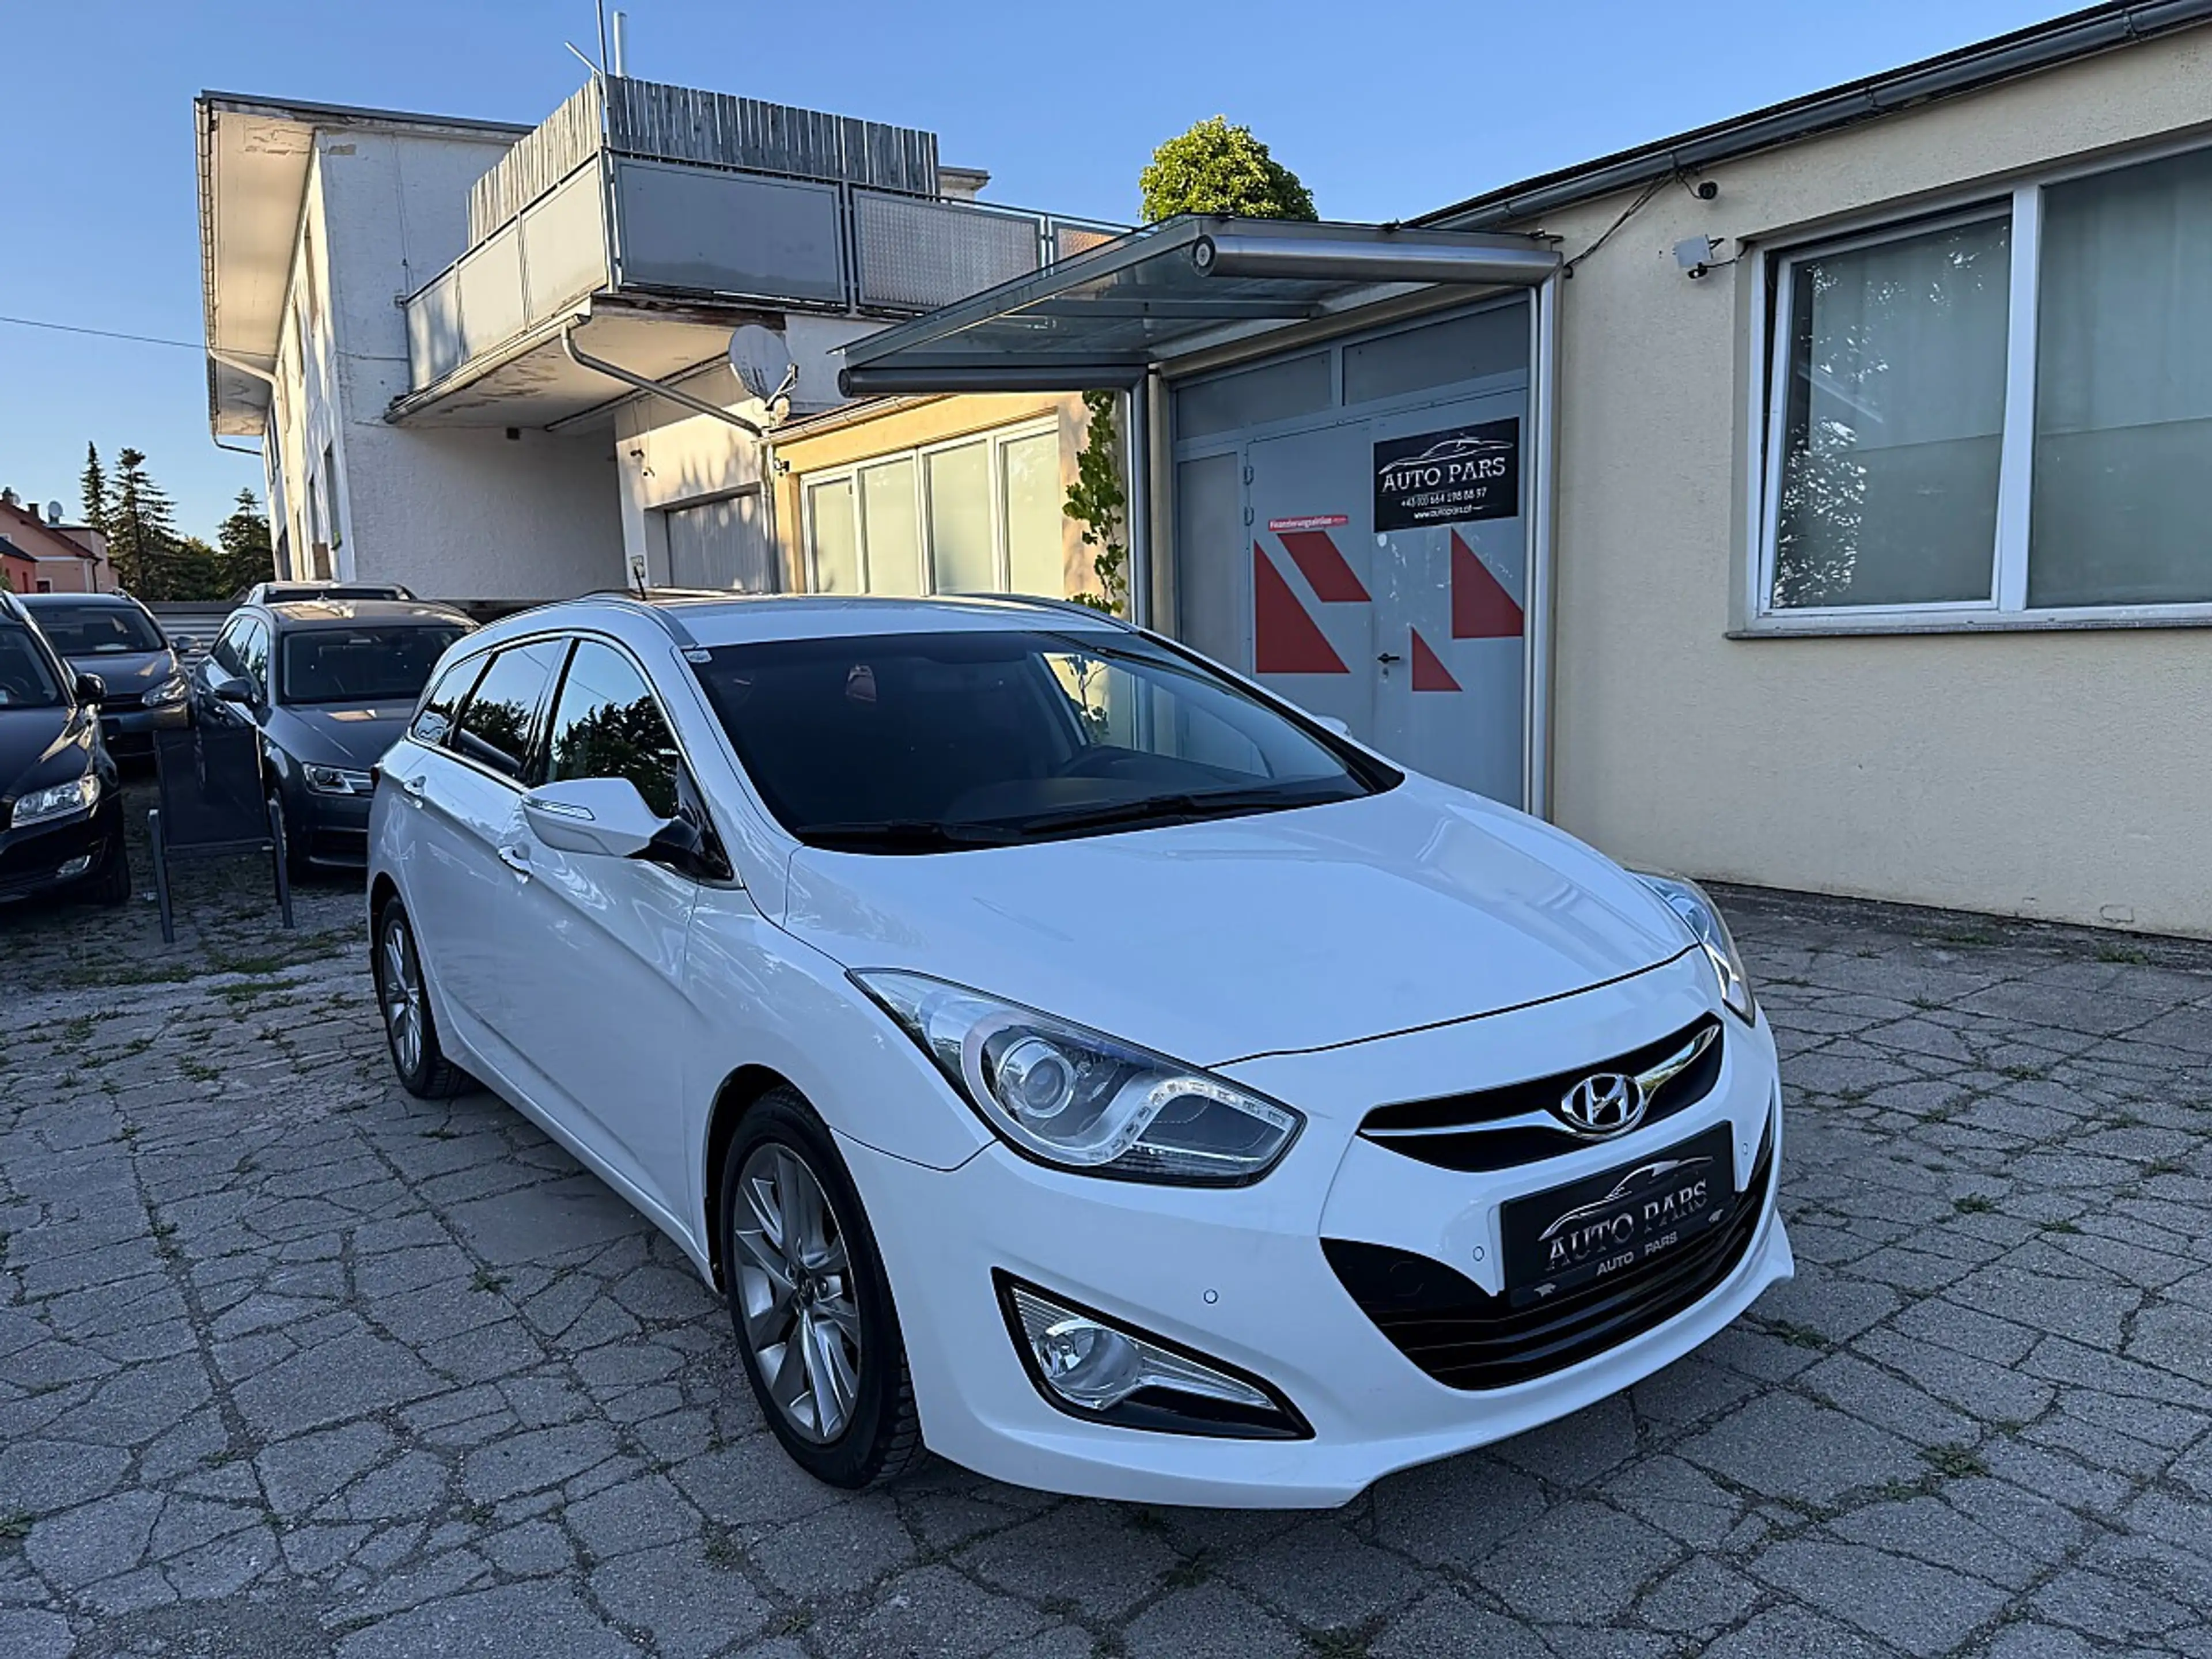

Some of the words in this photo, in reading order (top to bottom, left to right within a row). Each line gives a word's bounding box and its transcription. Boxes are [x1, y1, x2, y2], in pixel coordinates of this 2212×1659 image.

[1382, 468, 1441, 492] AUTO
[1448, 457, 1506, 484] PARS
[1546, 1213, 1634, 1271] AUTO
[1643, 1178, 1708, 1233] PARS
[1596, 1251, 1634, 1277] AUTO
[1644, 1231, 1678, 1256] PARS
